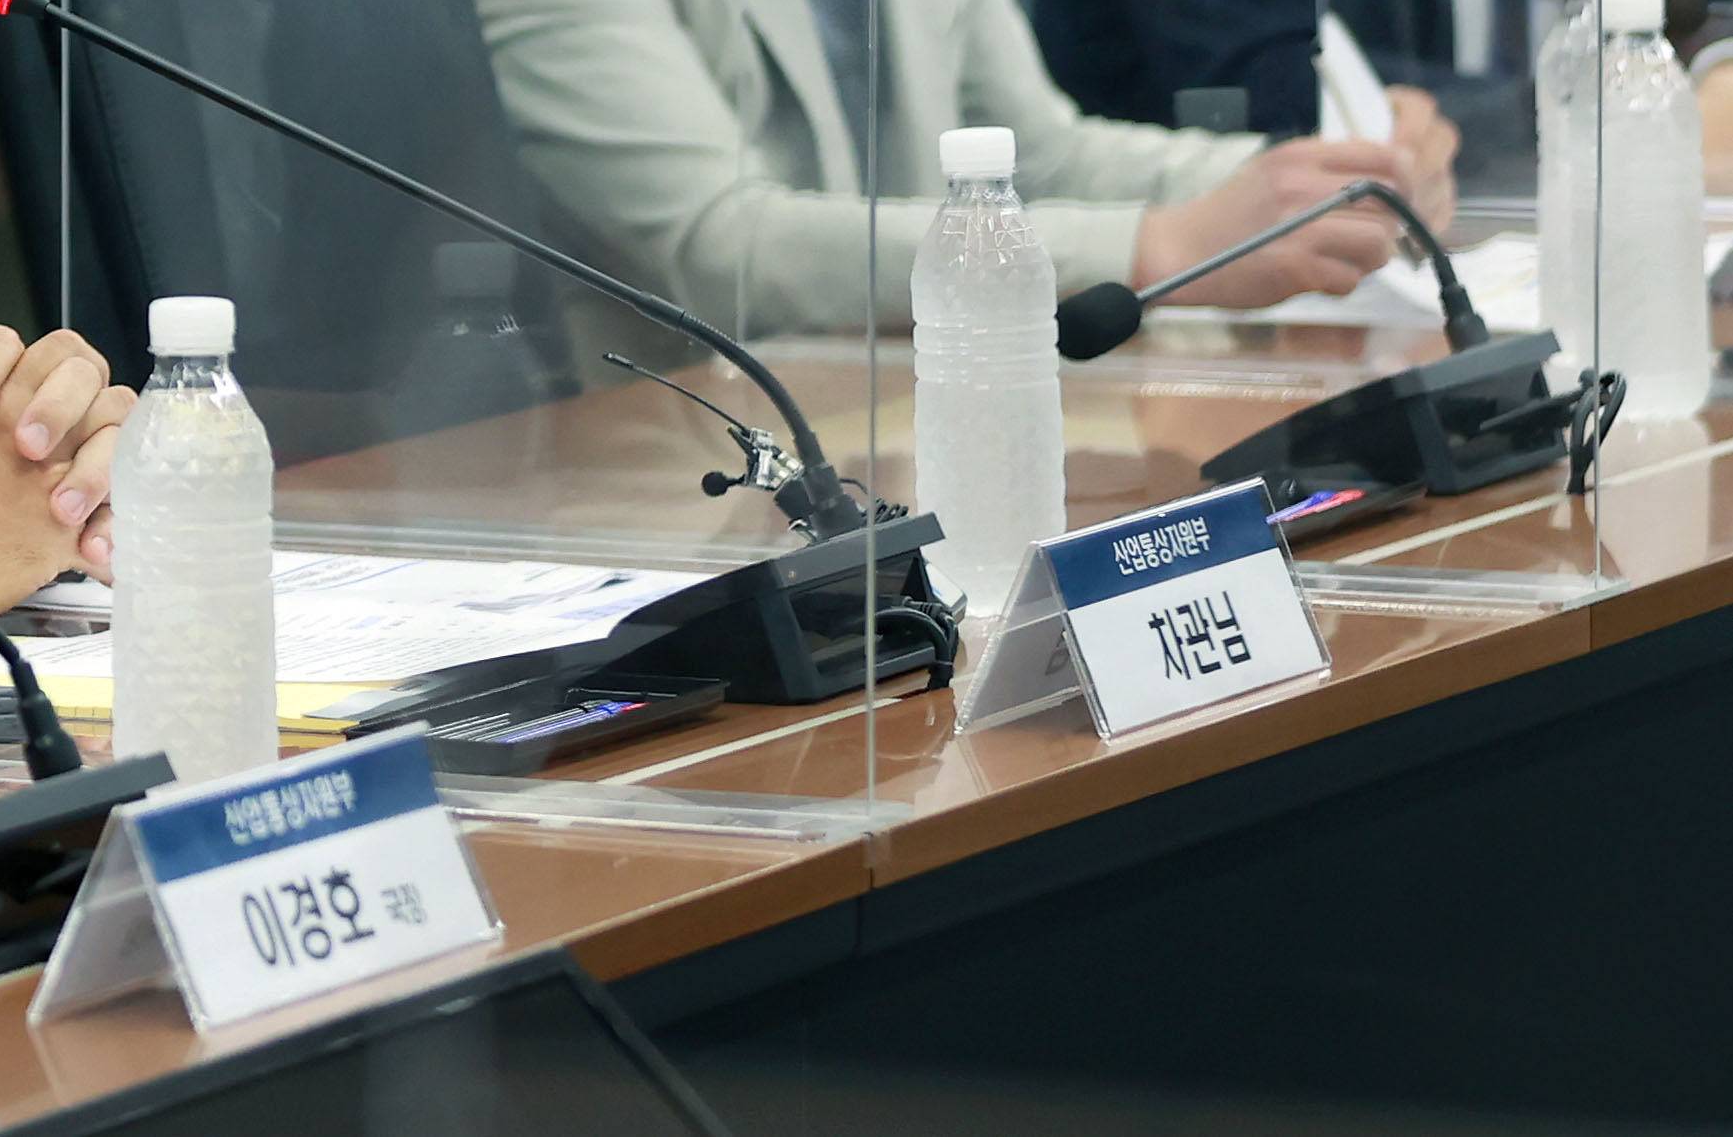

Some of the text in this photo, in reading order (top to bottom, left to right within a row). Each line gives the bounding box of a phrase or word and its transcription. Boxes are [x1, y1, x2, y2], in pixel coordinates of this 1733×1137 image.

[1112, 516, 1211, 576] 산업통상자원부
[1148, 590, 1251, 680] 차관님
[224, 769, 357, 847] 산업통상자원부
[242, 865, 375, 966] 이경호
